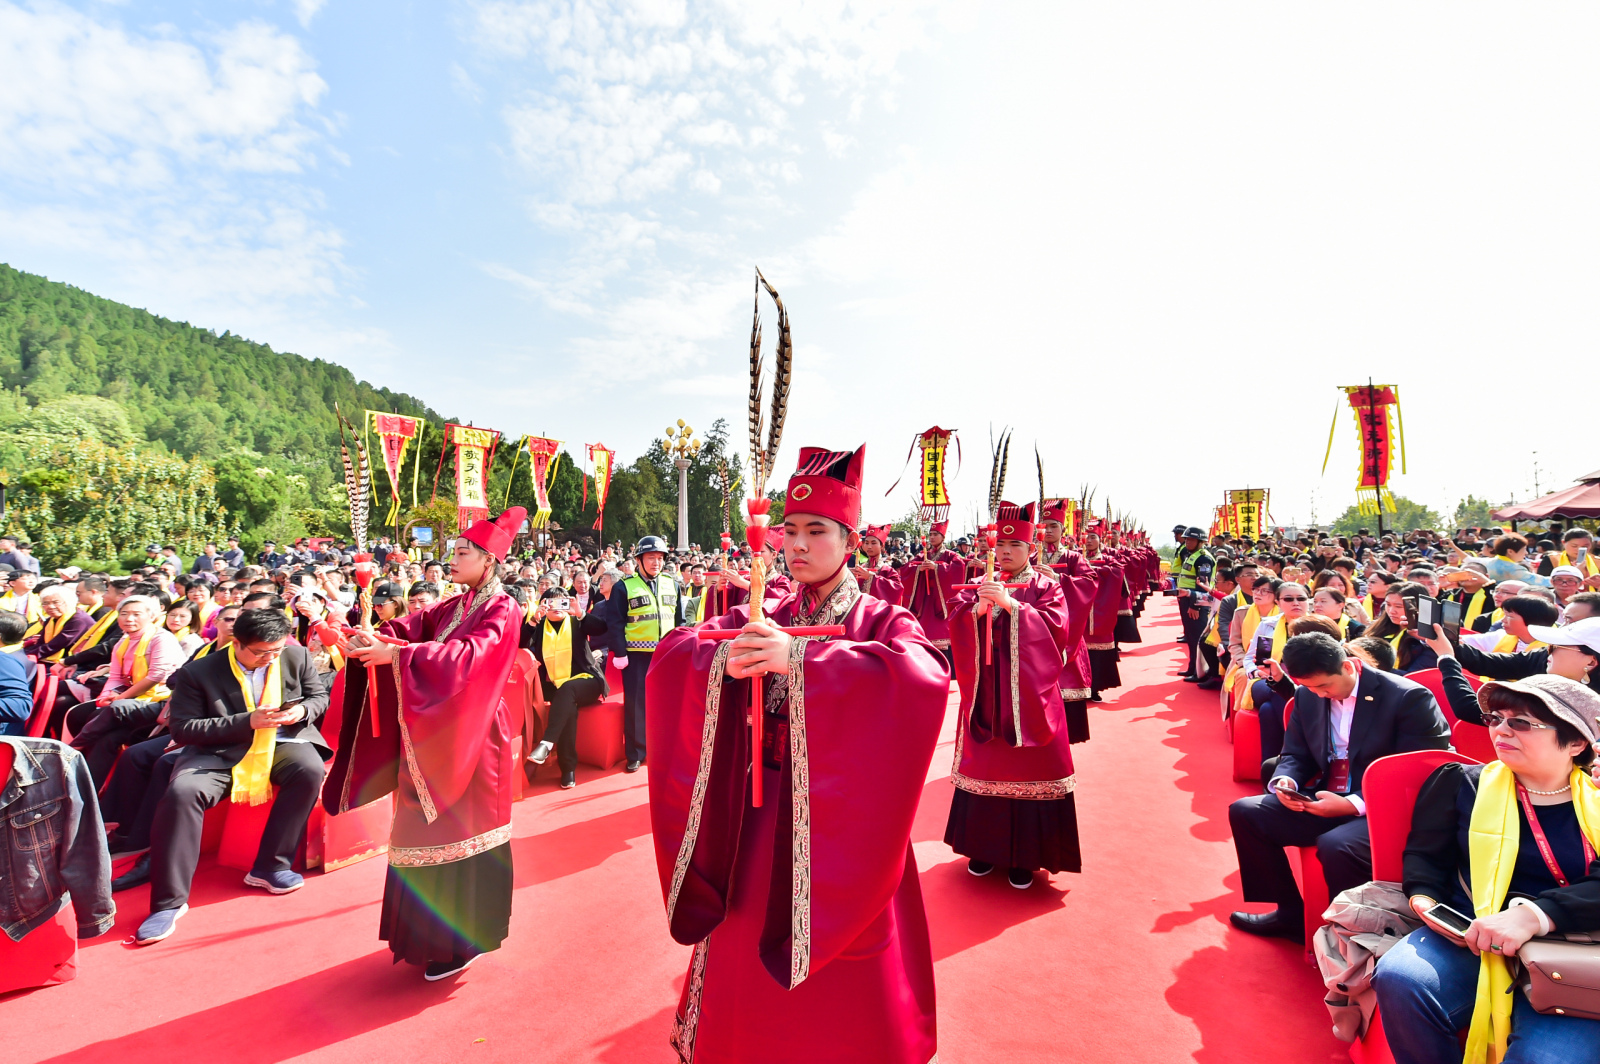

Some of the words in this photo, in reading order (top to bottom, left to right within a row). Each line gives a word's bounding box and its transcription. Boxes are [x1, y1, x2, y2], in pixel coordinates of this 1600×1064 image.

[464, 449, 480, 501] 敬天祈福
[630, 595, 650, 608] 泰山
